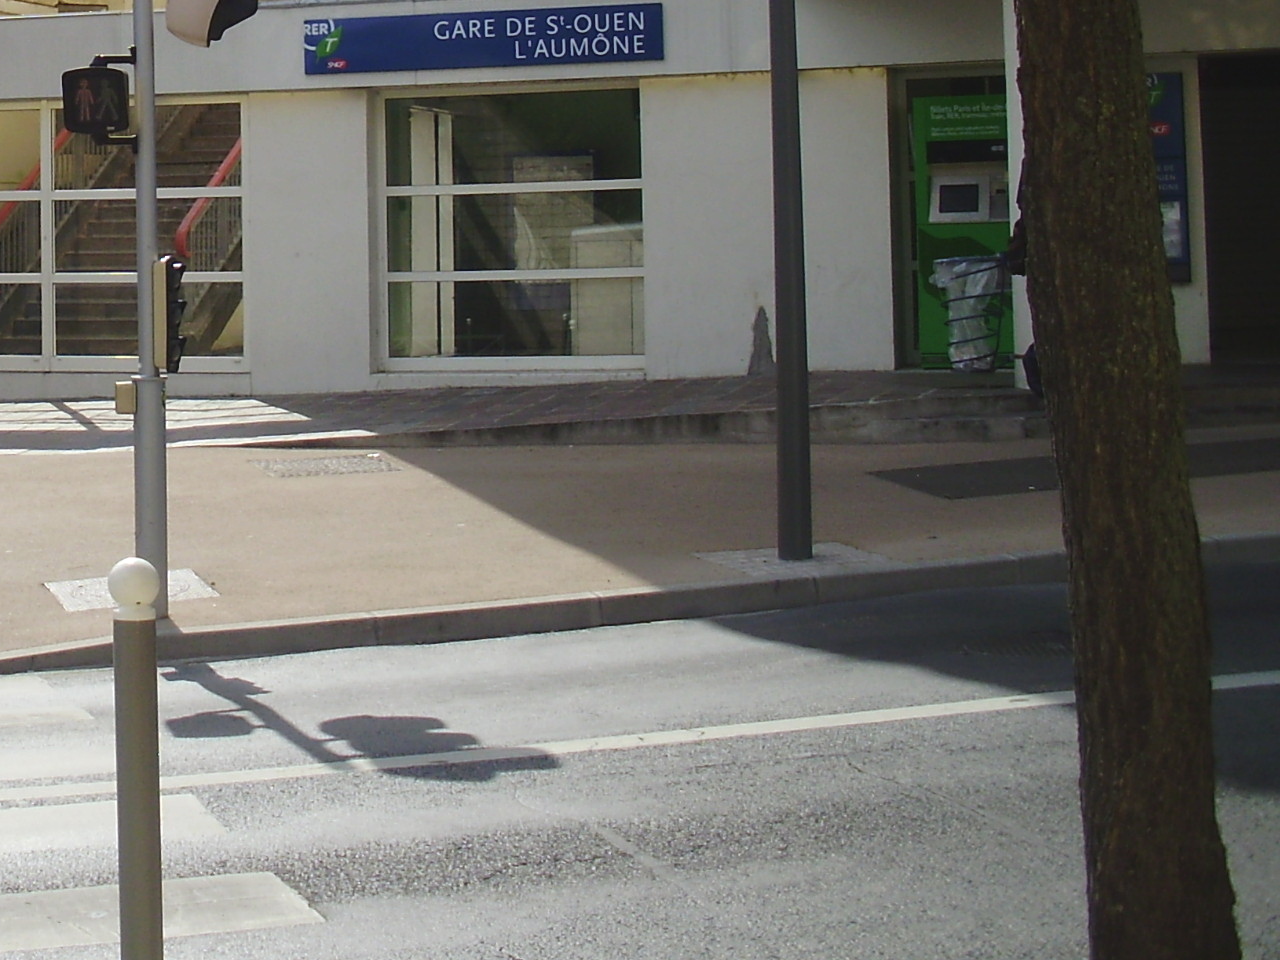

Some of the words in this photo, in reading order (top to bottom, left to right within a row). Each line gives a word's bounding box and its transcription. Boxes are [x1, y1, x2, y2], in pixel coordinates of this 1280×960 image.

[304, 23, 329, 36] RER
[433, 19, 495, 40] GARE
[506, 16, 535, 37] DE
[514, 33, 646, 59] L'AUMÔNE
[1150, 125, 1169, 134] NCF
